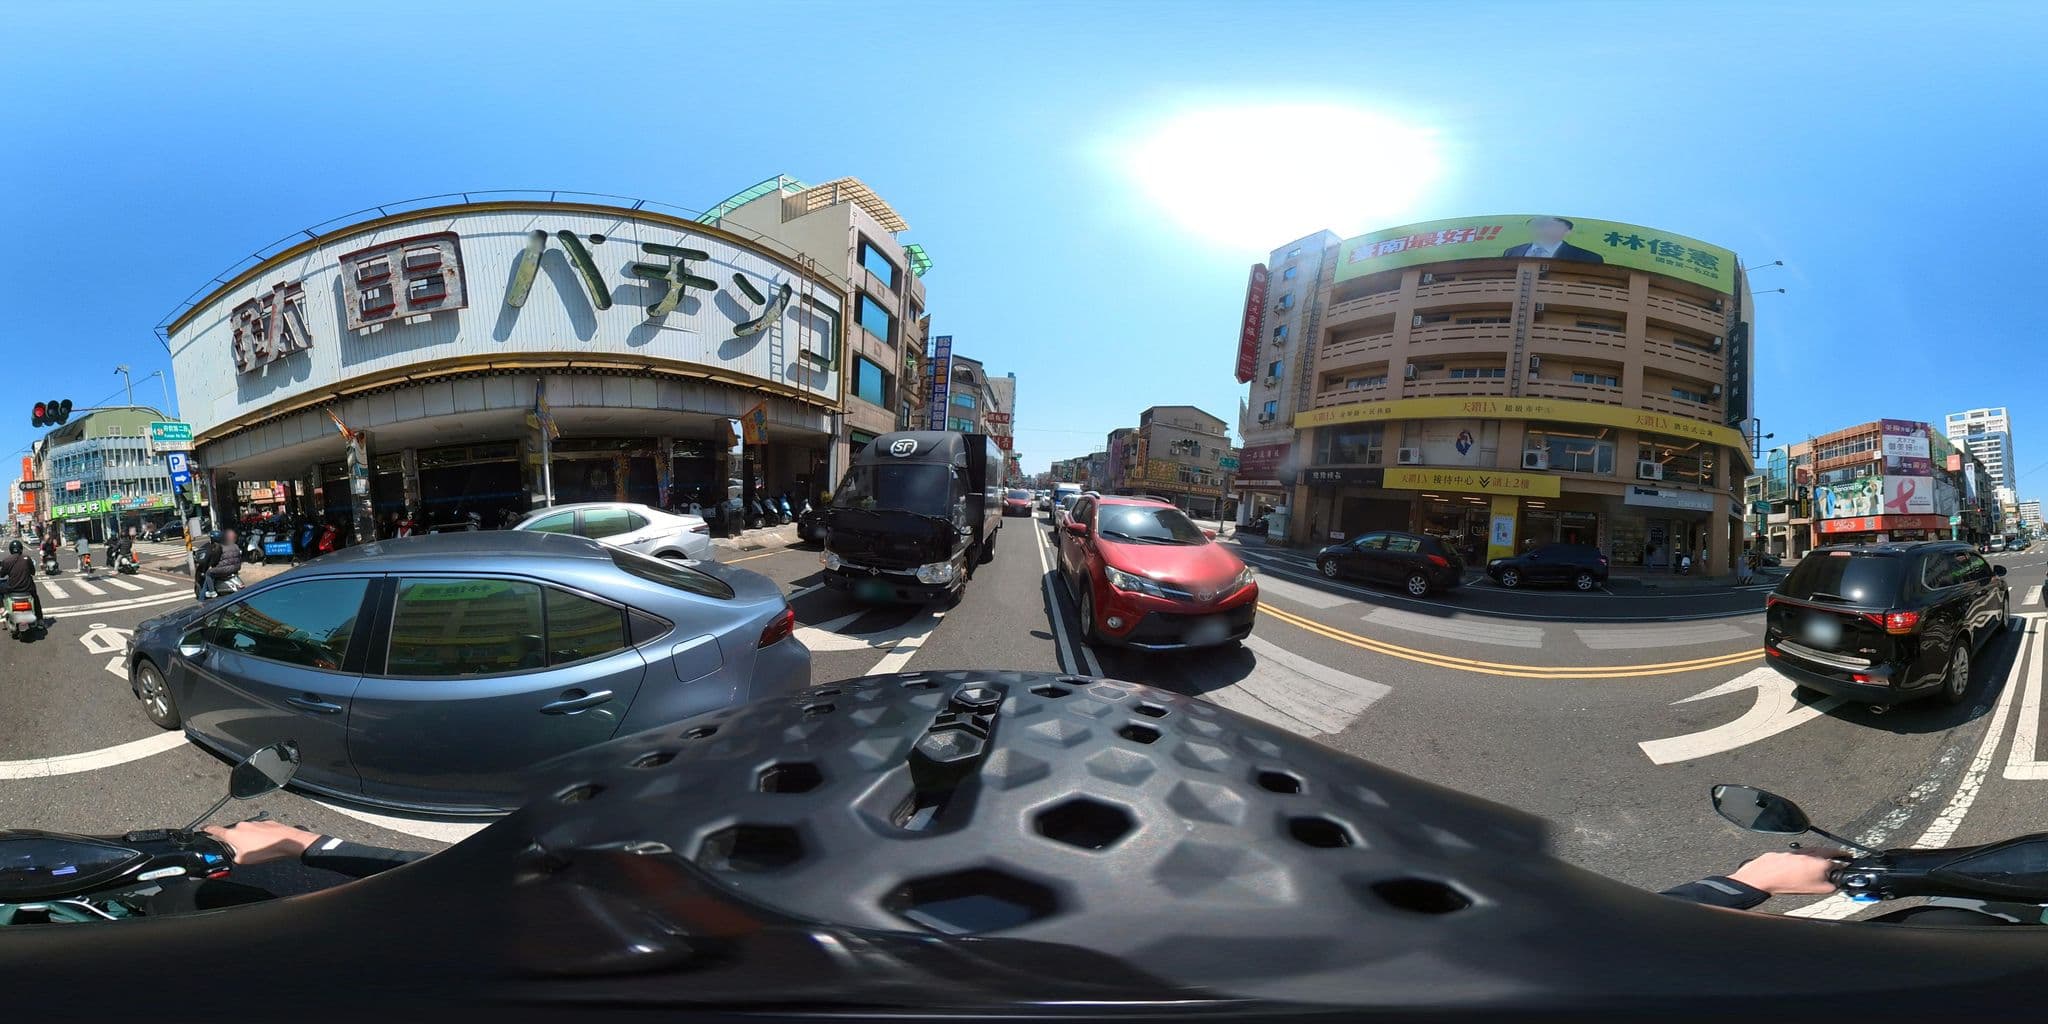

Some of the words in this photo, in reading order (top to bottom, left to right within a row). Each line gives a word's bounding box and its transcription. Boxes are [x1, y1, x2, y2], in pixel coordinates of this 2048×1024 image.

[1603, 231, 1720, 272] 林俊憲
[895, 442, 912, 452] SF
[171, 457, 180, 470] P
[1433, 474, 1474, 485] 接待中心
[1492, 477, 1530, 489] 請上2樓
[57, 502, 100, 515] 手機配件
